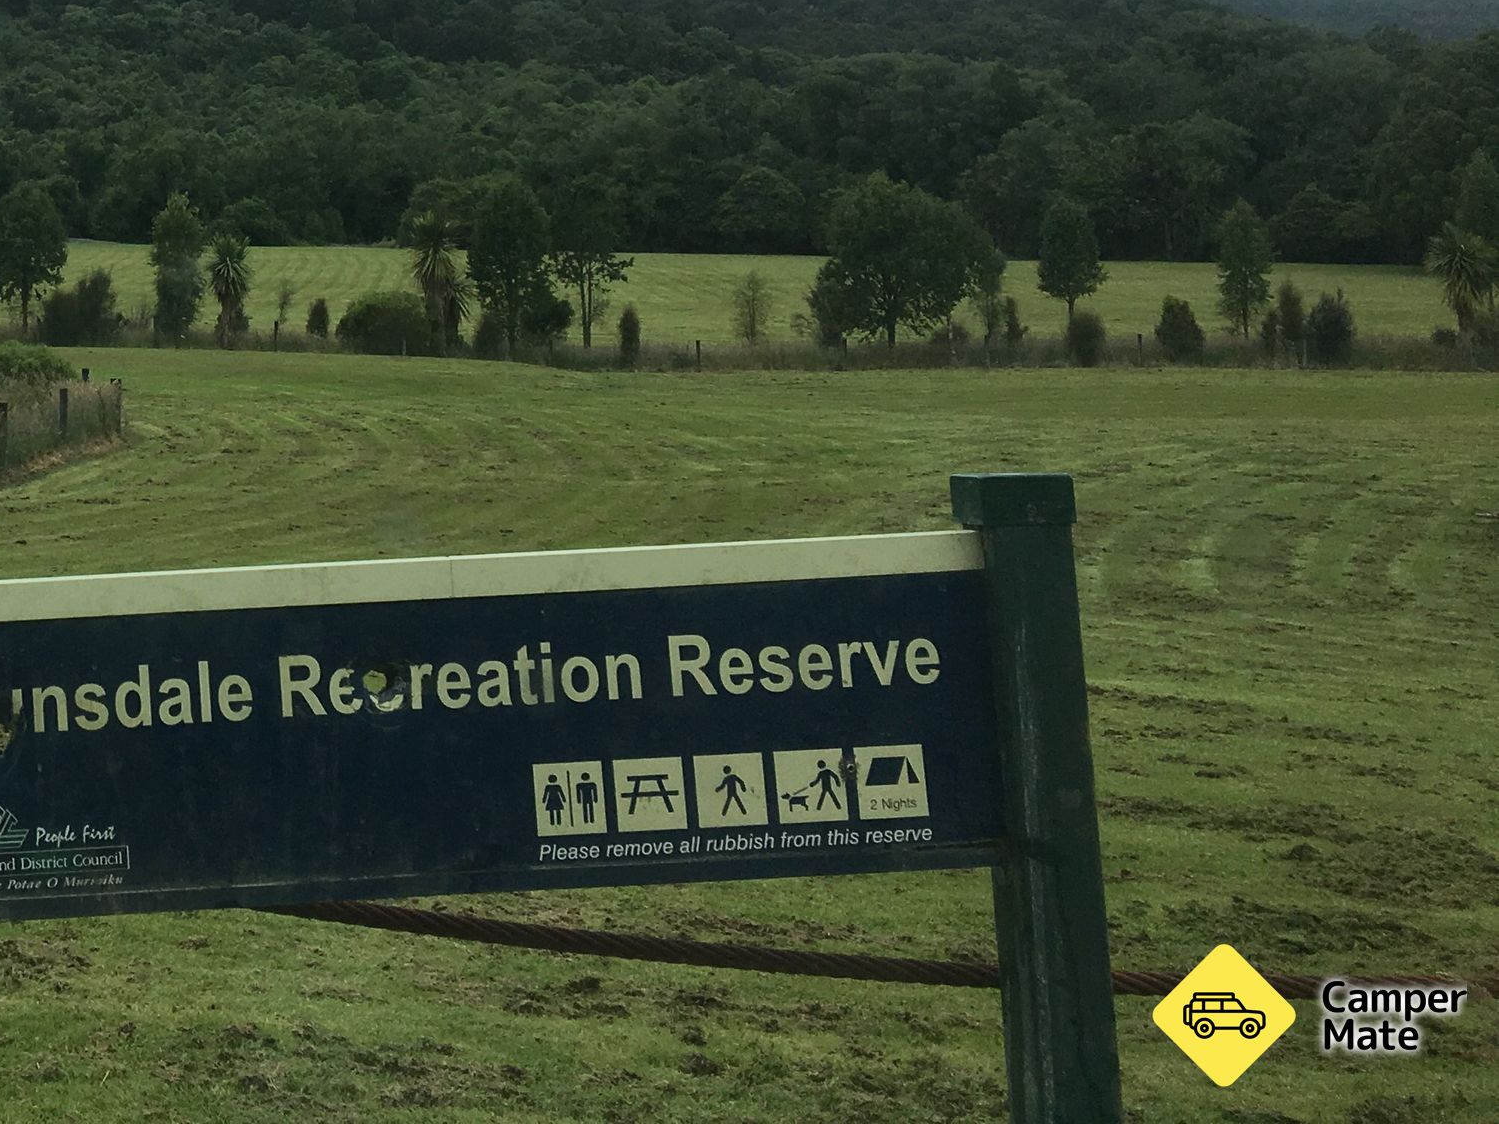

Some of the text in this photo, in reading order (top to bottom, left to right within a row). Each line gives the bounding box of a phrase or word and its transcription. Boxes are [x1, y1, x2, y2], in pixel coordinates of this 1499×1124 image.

[667, 633, 941, 697] Reserve
[869, 797, 918, 811] 2 Nights
[35, 824, 116, 848] People First
[539, 828, 933, 861] Please remove all rubbish from this reserve
[21, 855, 68, 870] District
[72, 851, 123, 867] Council
[7, 878, 42, 890] Potae
[47, 877, 59, 888] O
[63, 873, 123, 888] Muriiku
